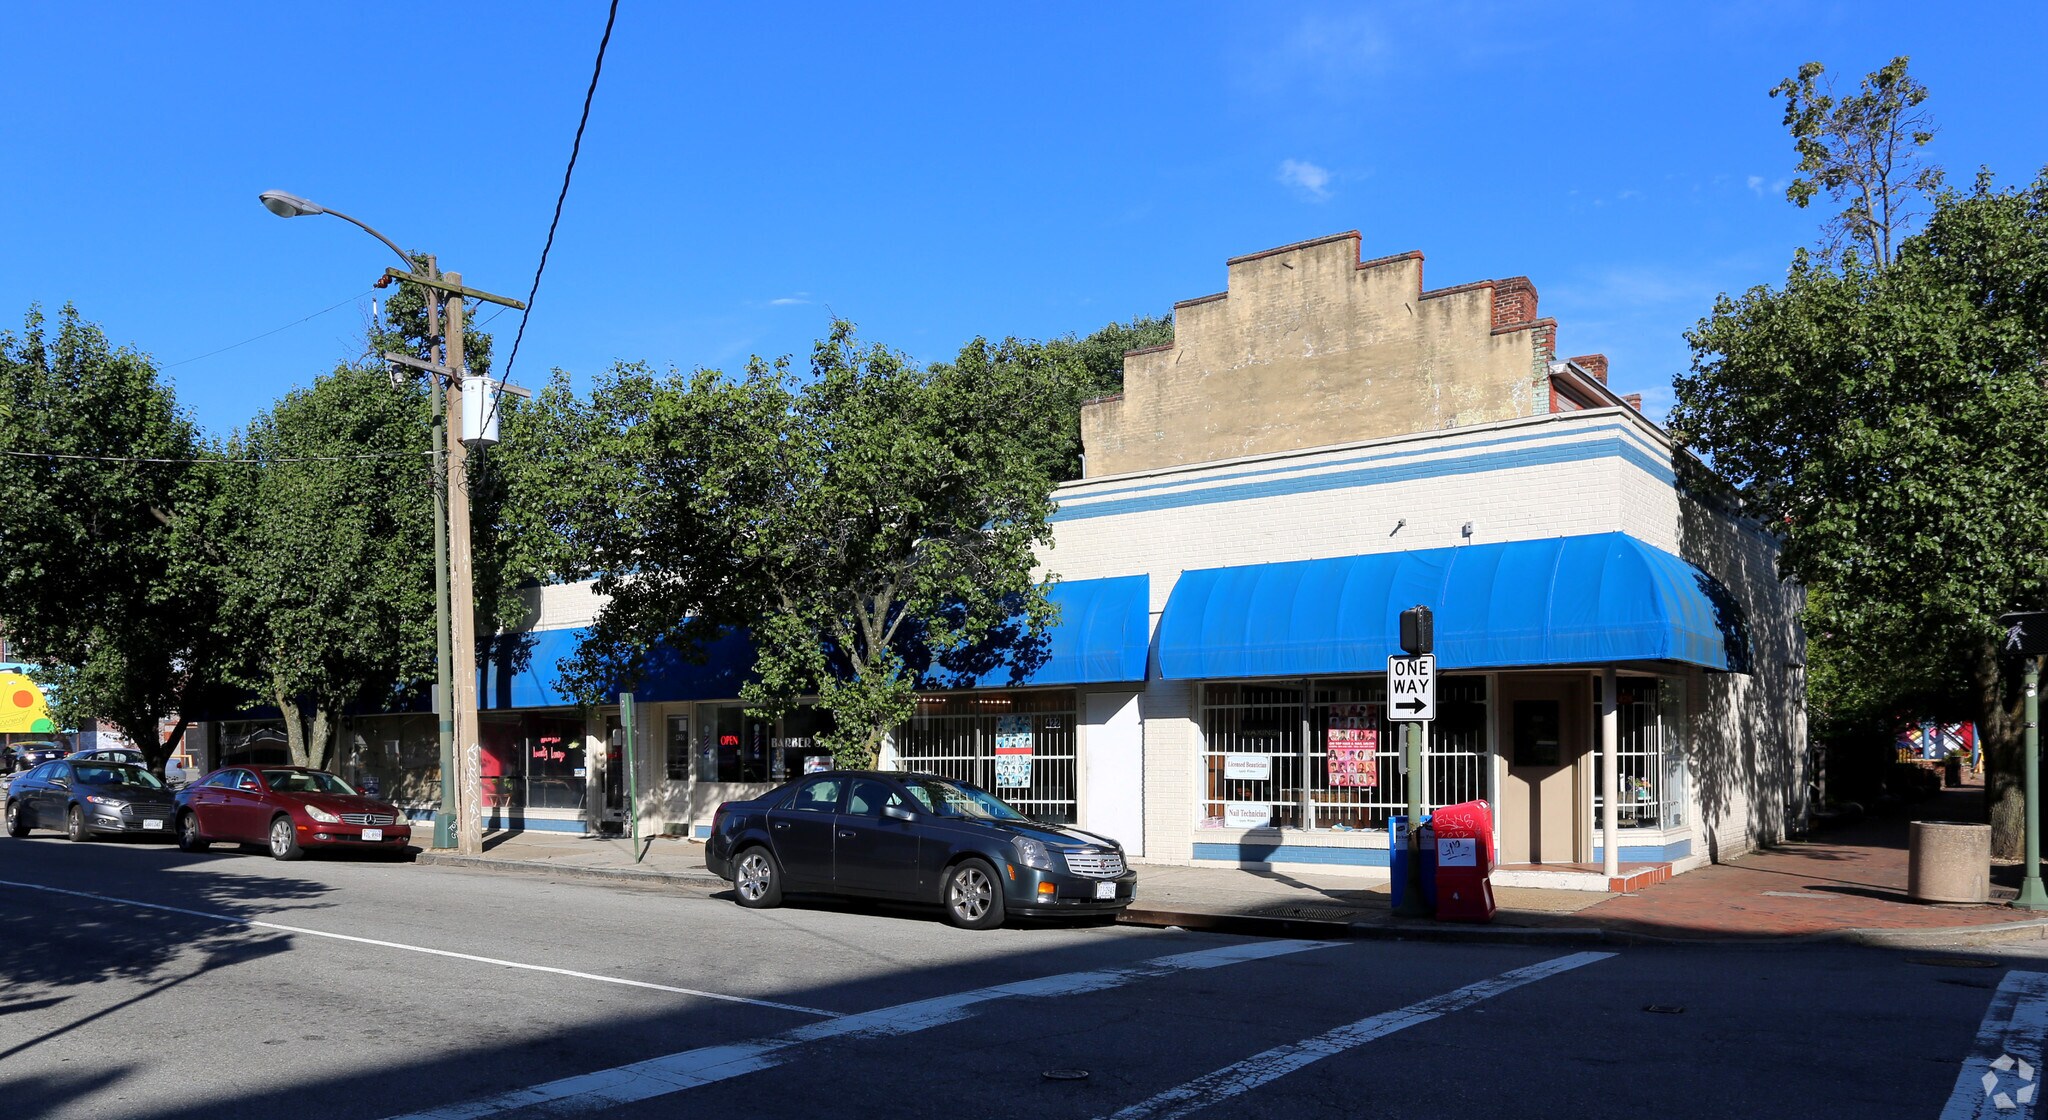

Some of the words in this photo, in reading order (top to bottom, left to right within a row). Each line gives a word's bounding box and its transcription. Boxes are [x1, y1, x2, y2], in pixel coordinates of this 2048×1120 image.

[1395, 661, 1428, 676] ONE
[1393, 679, 1429, 694] WAY
[1046, 718, 1060, 727] 422
[720, 735, 738, 746] OPEN
[771, 737, 811, 748] BARBER
[1229, 809, 1239, 817] Nail
